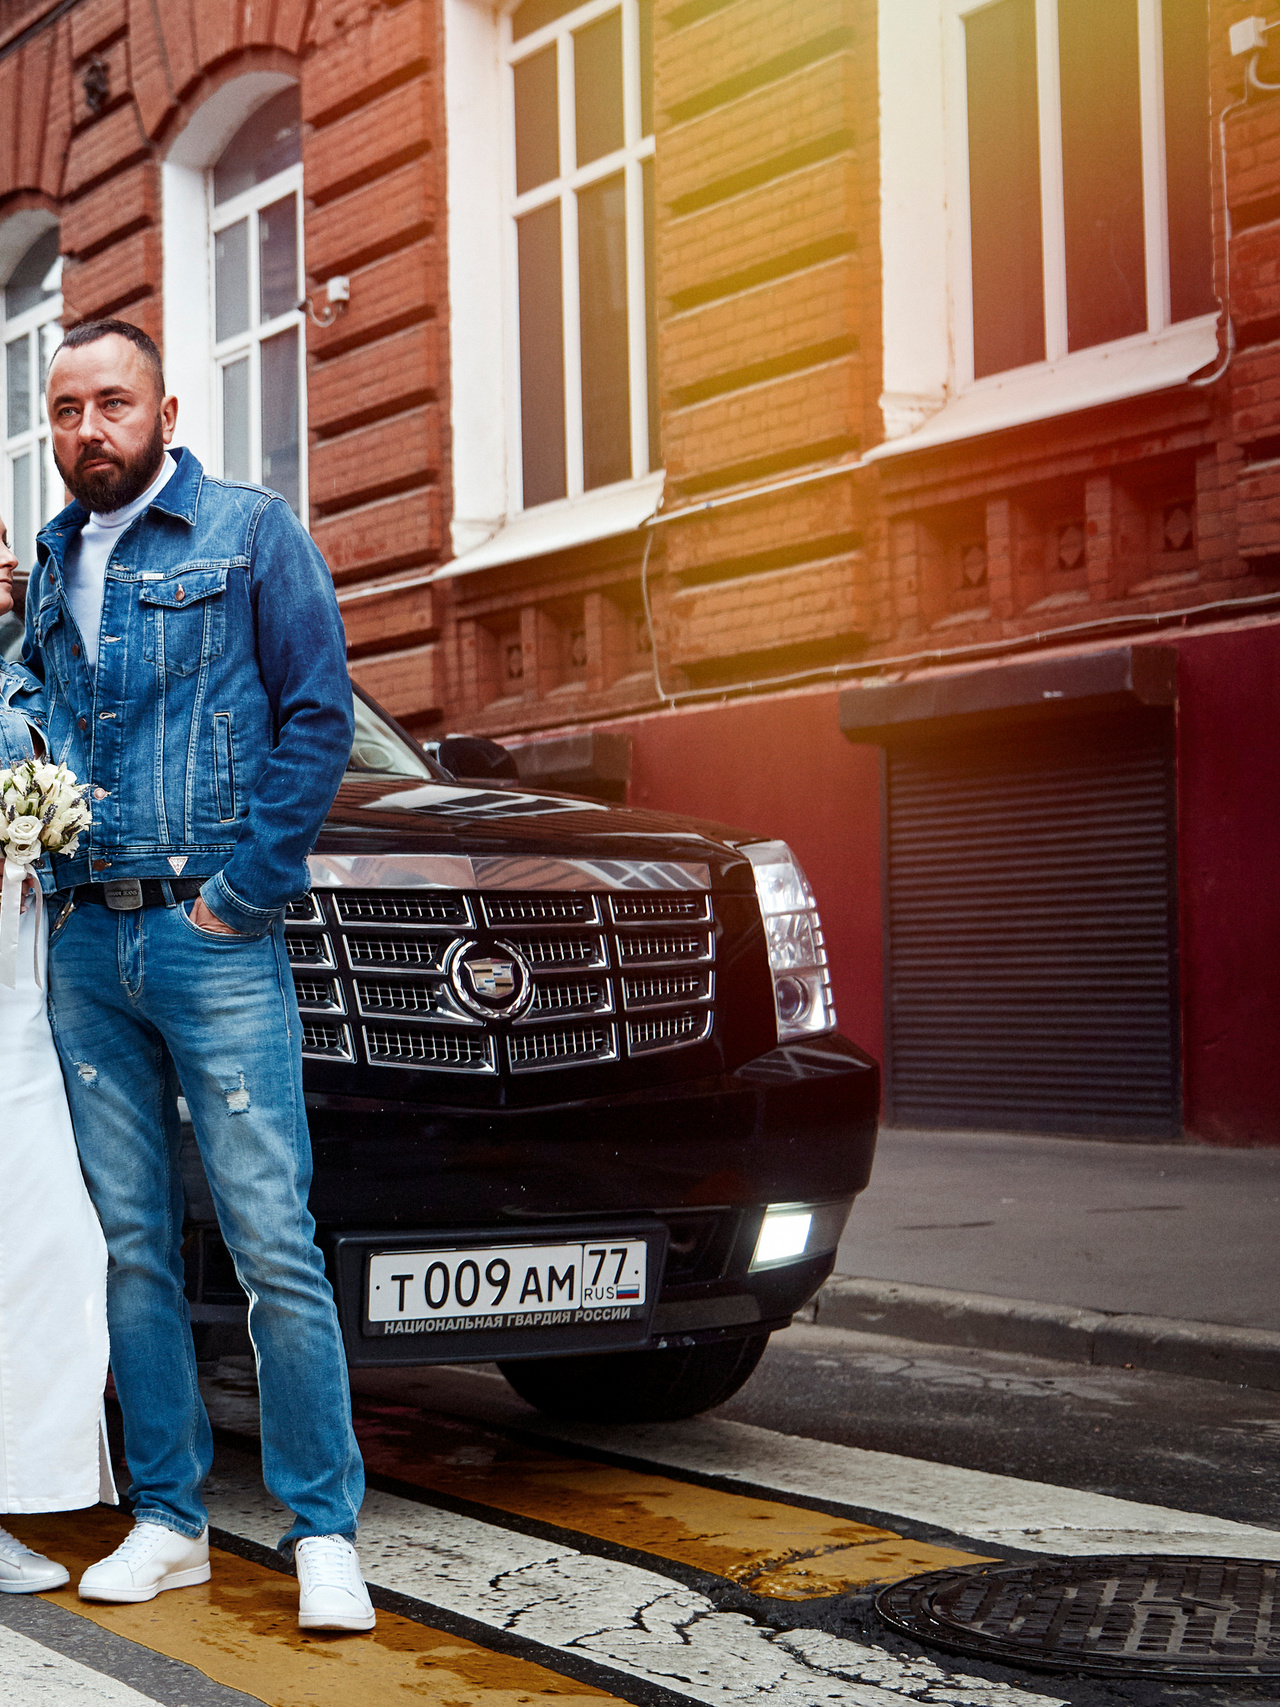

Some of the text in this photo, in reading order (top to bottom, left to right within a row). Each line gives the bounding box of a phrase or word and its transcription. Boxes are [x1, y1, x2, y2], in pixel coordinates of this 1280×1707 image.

[588, 1248, 628, 1286] 77
[584, 1287, 614, 1301] RUS
[384, 1306, 631, 1335] НАЦИОНАЛЬНАЯ ГВАРДИЯ РОССИИ
